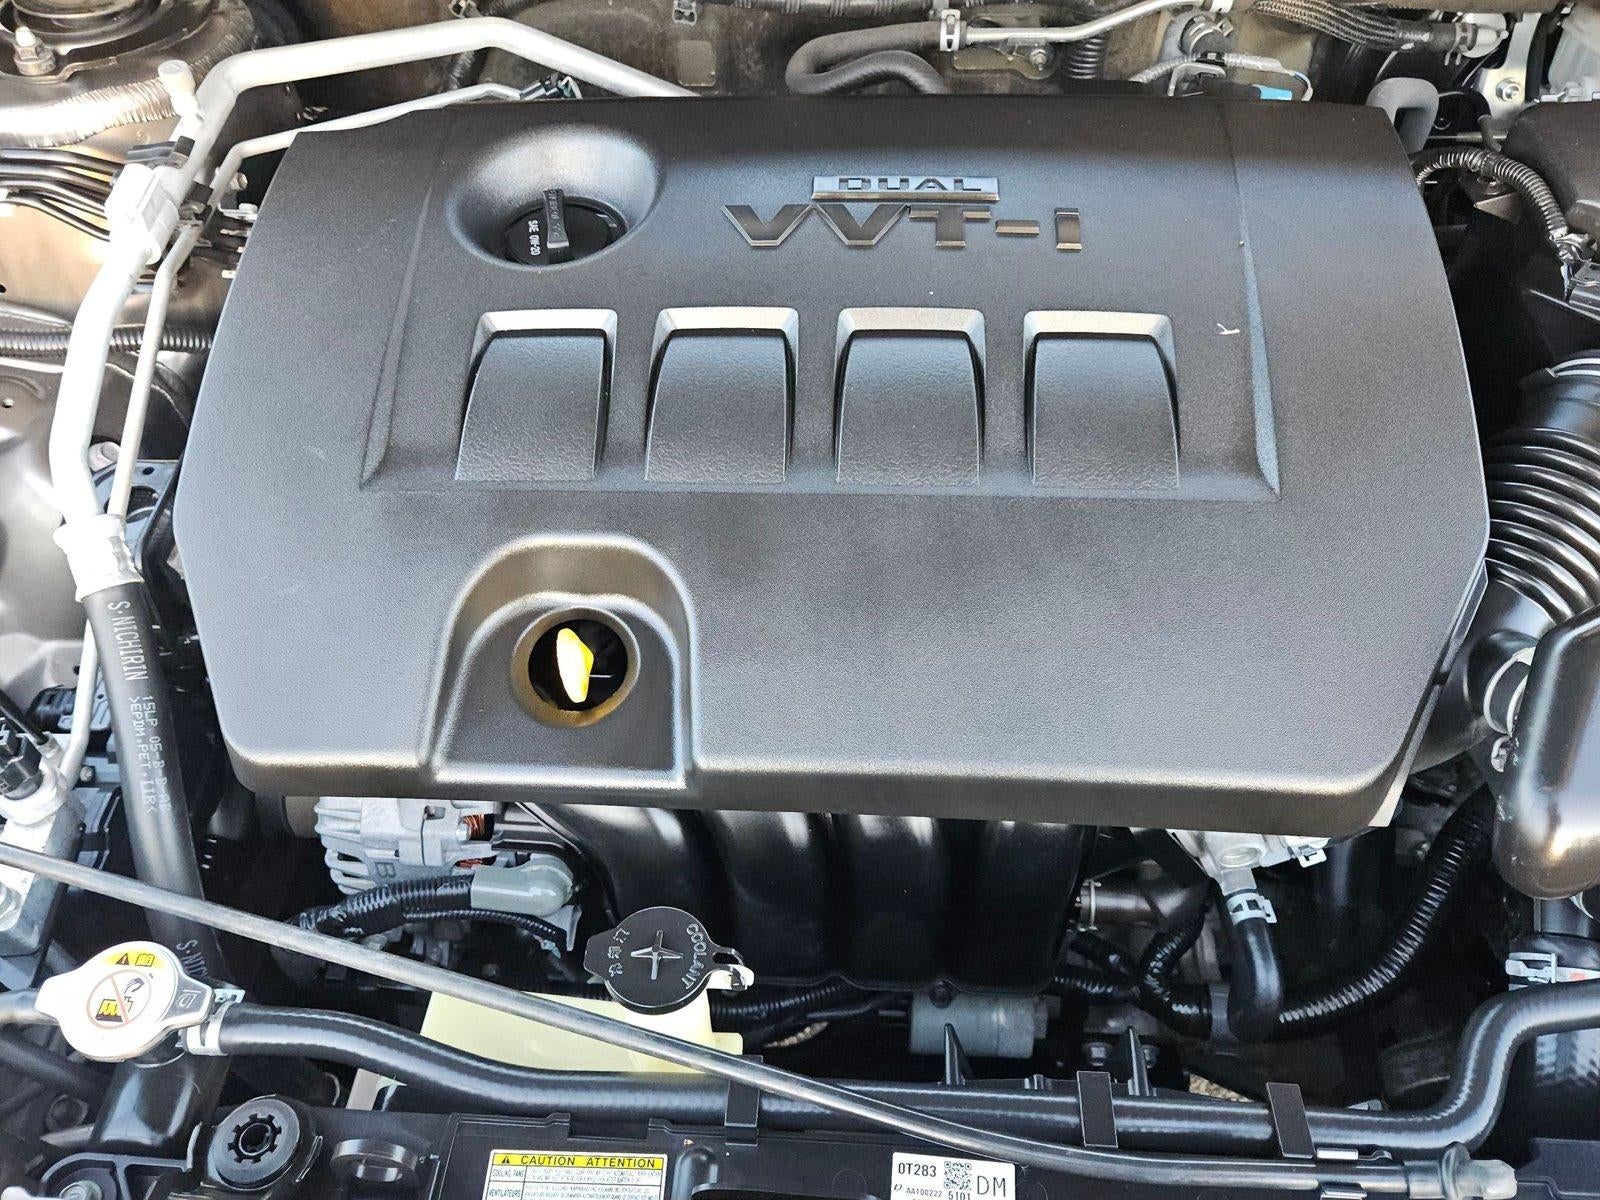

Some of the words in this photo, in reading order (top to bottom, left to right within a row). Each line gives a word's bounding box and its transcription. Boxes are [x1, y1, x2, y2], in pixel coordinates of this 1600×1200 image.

[528, 220, 539, 233] SAE
[529, 235, 541, 256] 0W-20
[142, 696, 159, 727] 15LP
[681, 924, 707, 990] COOLANT
[520, 1156, 575, 1166] CAUTION
[586, 1158, 656, 1168] ATTENTION
[977, 1175, 1006, 1198] DM
